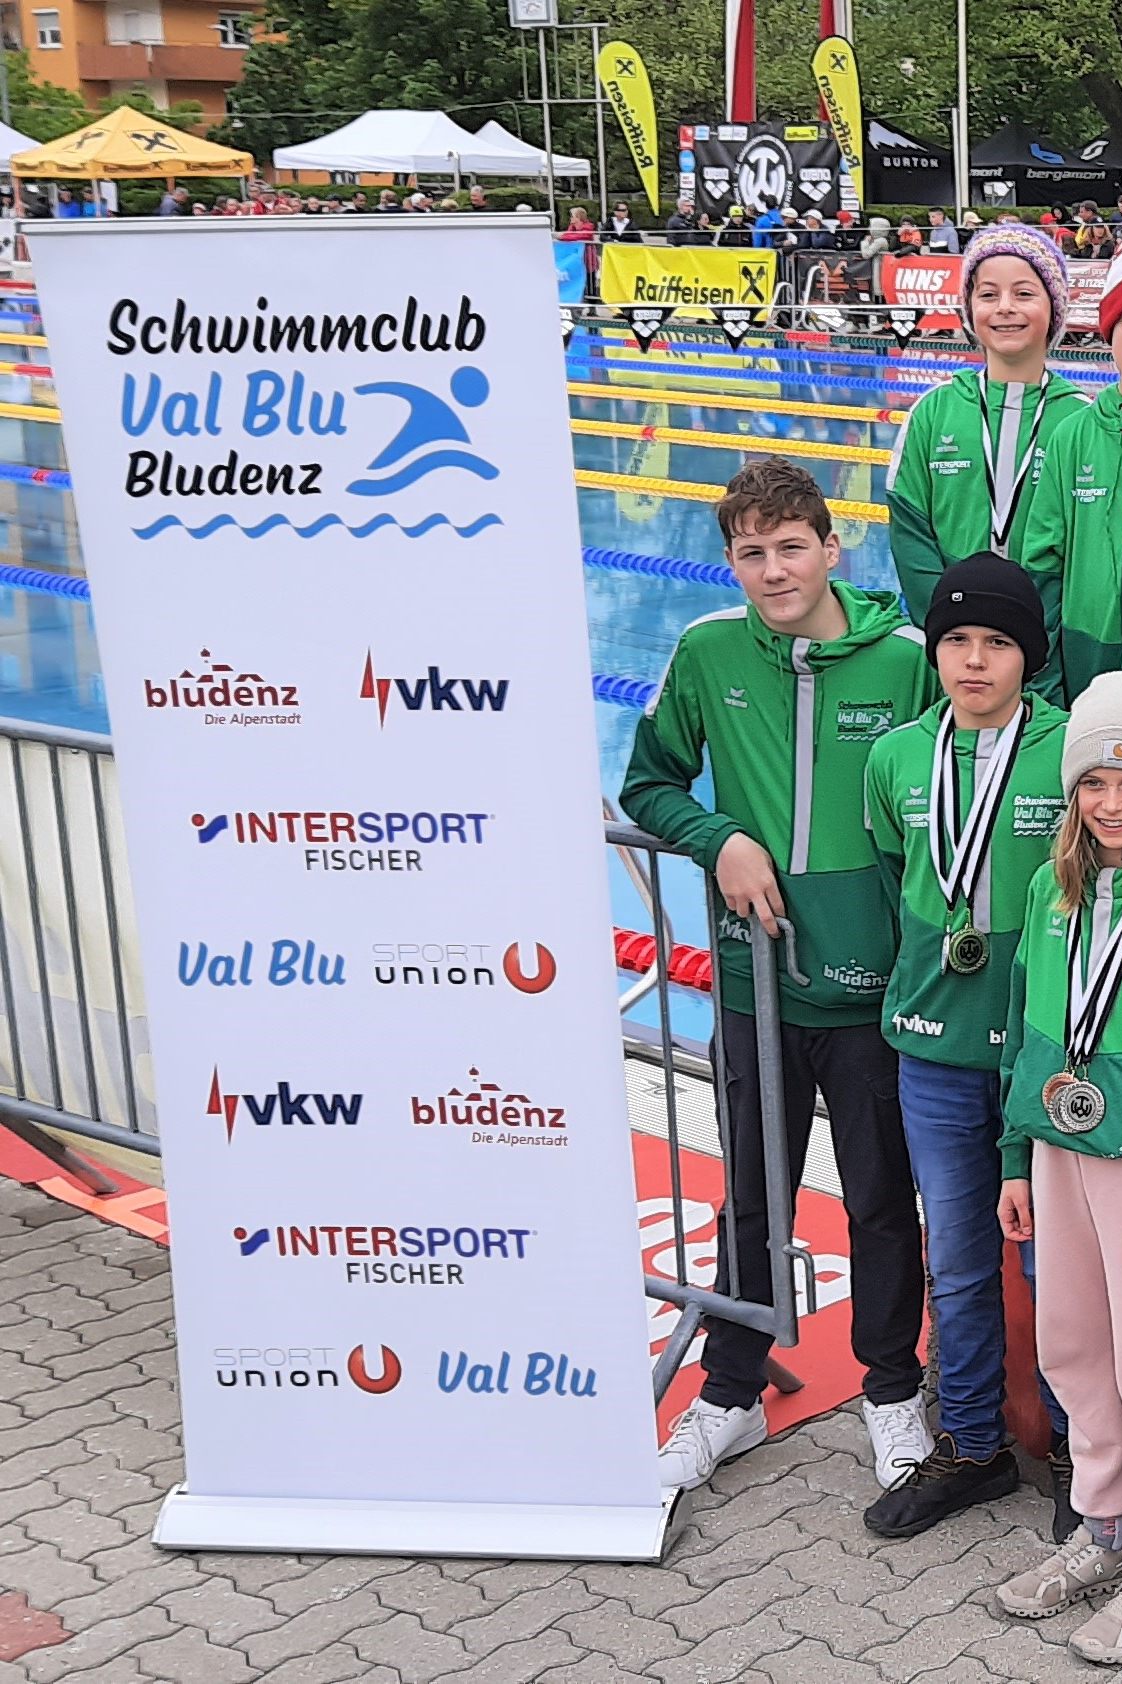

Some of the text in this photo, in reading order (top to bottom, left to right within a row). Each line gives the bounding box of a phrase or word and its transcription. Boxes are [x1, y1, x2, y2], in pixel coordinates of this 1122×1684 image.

[883, 156, 939, 169] BURTON
[1026, 167, 1106, 182] bergamont
[634, 275, 735, 306] Raiffeisen
[107, 295, 487, 354] Schwimmclub
[121, 369, 348, 437] Val Blu
[124, 450, 323, 498] Bludenz
[144, 678, 299, 708] bludenz
[393, 666, 510, 712] vkw
[204, 712, 302, 726] Die Alpenstadt
[837, 711, 873, 724] Val Blu
[1013, 806, 1034, 819] Val
[234, 811, 489, 845] INTERSPORT
[304, 849, 423, 872] FISCHER
[178, 938, 347, 987] Val Blu
[371, 943, 496, 963] SPORT
[374, 966, 495, 986] union
[903, 1013, 945, 1037] vkw
[241, 1081, 364, 1126] vkw
[411, 1095, 567, 1129] bludenz
[471, 1131, 569, 1148] Die Alpenstadt
[276, 1226, 531, 1259] INTERSPORT
[346, 1262, 465, 1285] FISCHER
[213, 1347, 336, 1366] SPORT
[216, 1369, 339, 1388] union
[437, 1350, 598, 1397] Val Blu
